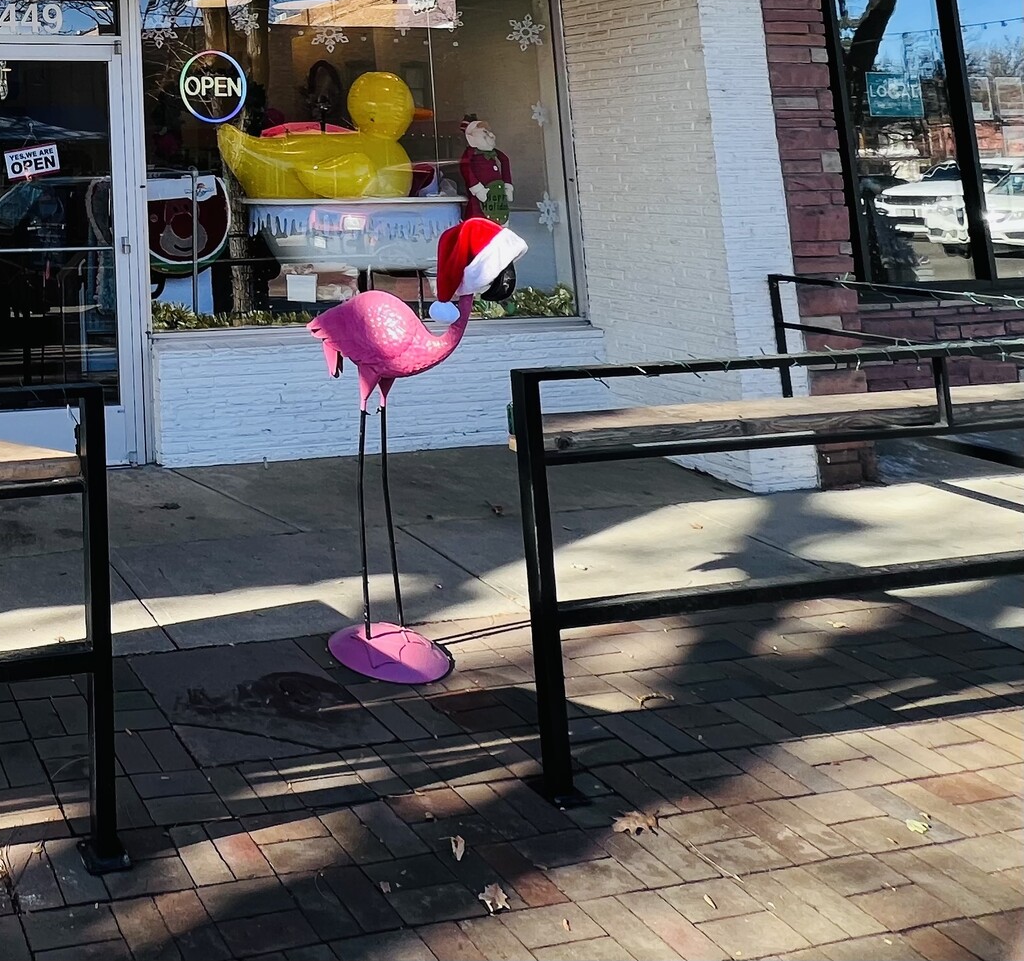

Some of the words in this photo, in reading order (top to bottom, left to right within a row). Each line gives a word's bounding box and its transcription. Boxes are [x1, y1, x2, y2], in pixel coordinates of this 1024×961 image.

[184, 76, 242, 97] OPEN
[39, 148, 54, 156] ARE
[11, 155, 56, 175] OPEN
